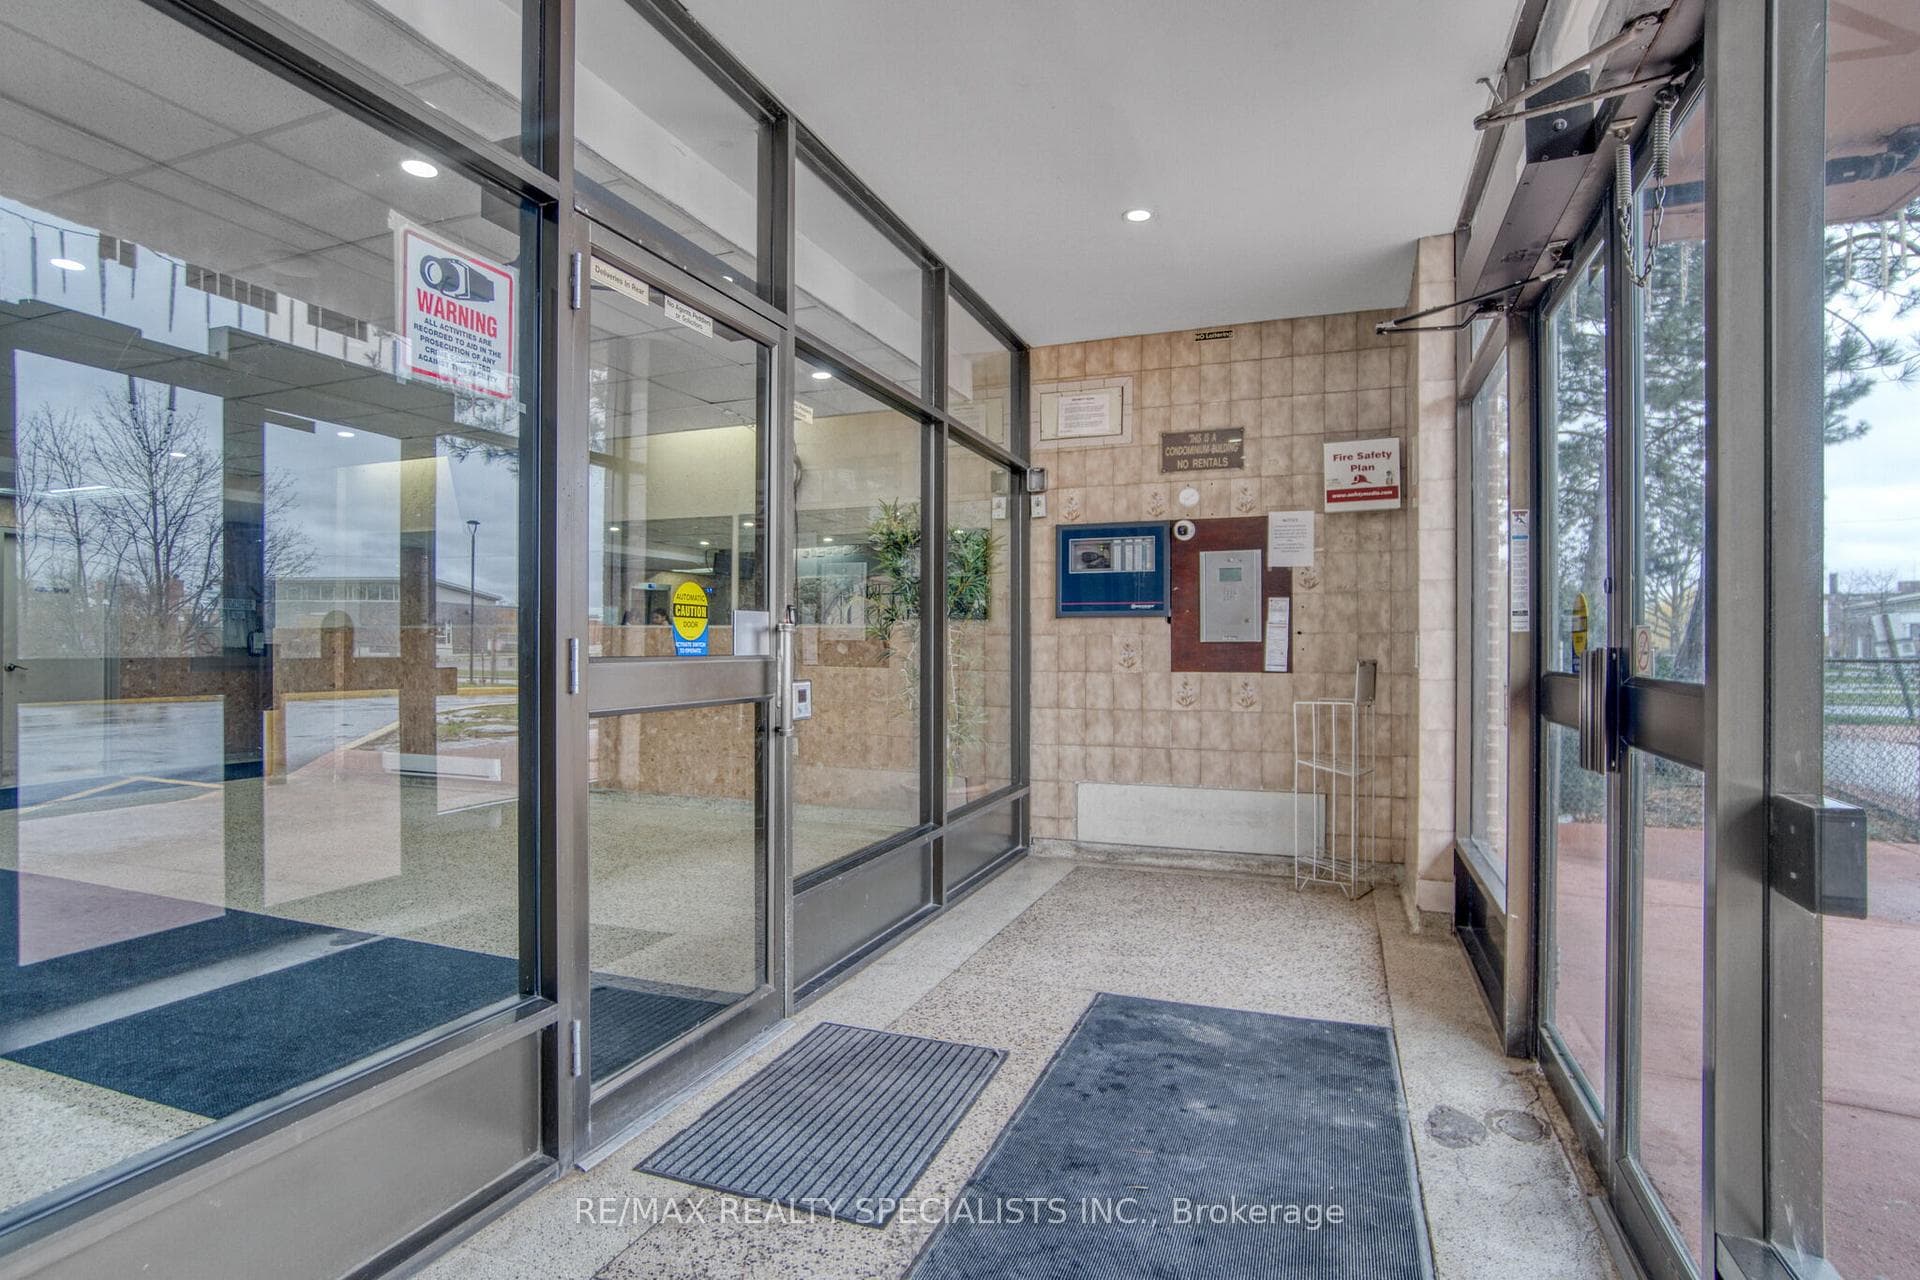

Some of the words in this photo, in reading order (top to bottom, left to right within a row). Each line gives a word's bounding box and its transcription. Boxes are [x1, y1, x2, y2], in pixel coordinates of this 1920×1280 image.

[595, 265, 624, 283] Deliveries
[631, 282, 645, 296] Rear
[666, 299, 674, 309] No
[416, 288, 497, 339] WARNING
[424, 317, 438, 328] ALL
[439, 323, 477, 342] ACTIVITIES
[478, 335, 492, 347] ARE
[413, 322, 453, 342] RECORDED
[455, 338, 465, 346] TO
[466, 342, 478, 352] AID
[480, 346, 487, 354] IN
[488, 349, 502, 360] THE
[420, 335, 470, 357] PROSECUTION
[472, 352, 480, 361] OF
[482, 356, 496, 366] ANY
[1189, 432, 1202, 443] THIS
[1204, 432, 1210, 442] IS
[1212, 432, 1217, 442] A
[1165, 444, 1210, 457] CONDOMINIUM
[1211, 442, 1239, 454] BUILDING
[1333, 453, 1353, 461] Fire
[1357, 450, 1392, 460] Safety
[1177, 459, 1189, 470] NO
[1192, 457, 1229, 469] RENTALS
[1350, 464, 1375, 472] Plan
[676, 593, 705, 602] AUTOMATIC
[675, 604, 707, 618] CAUTION
